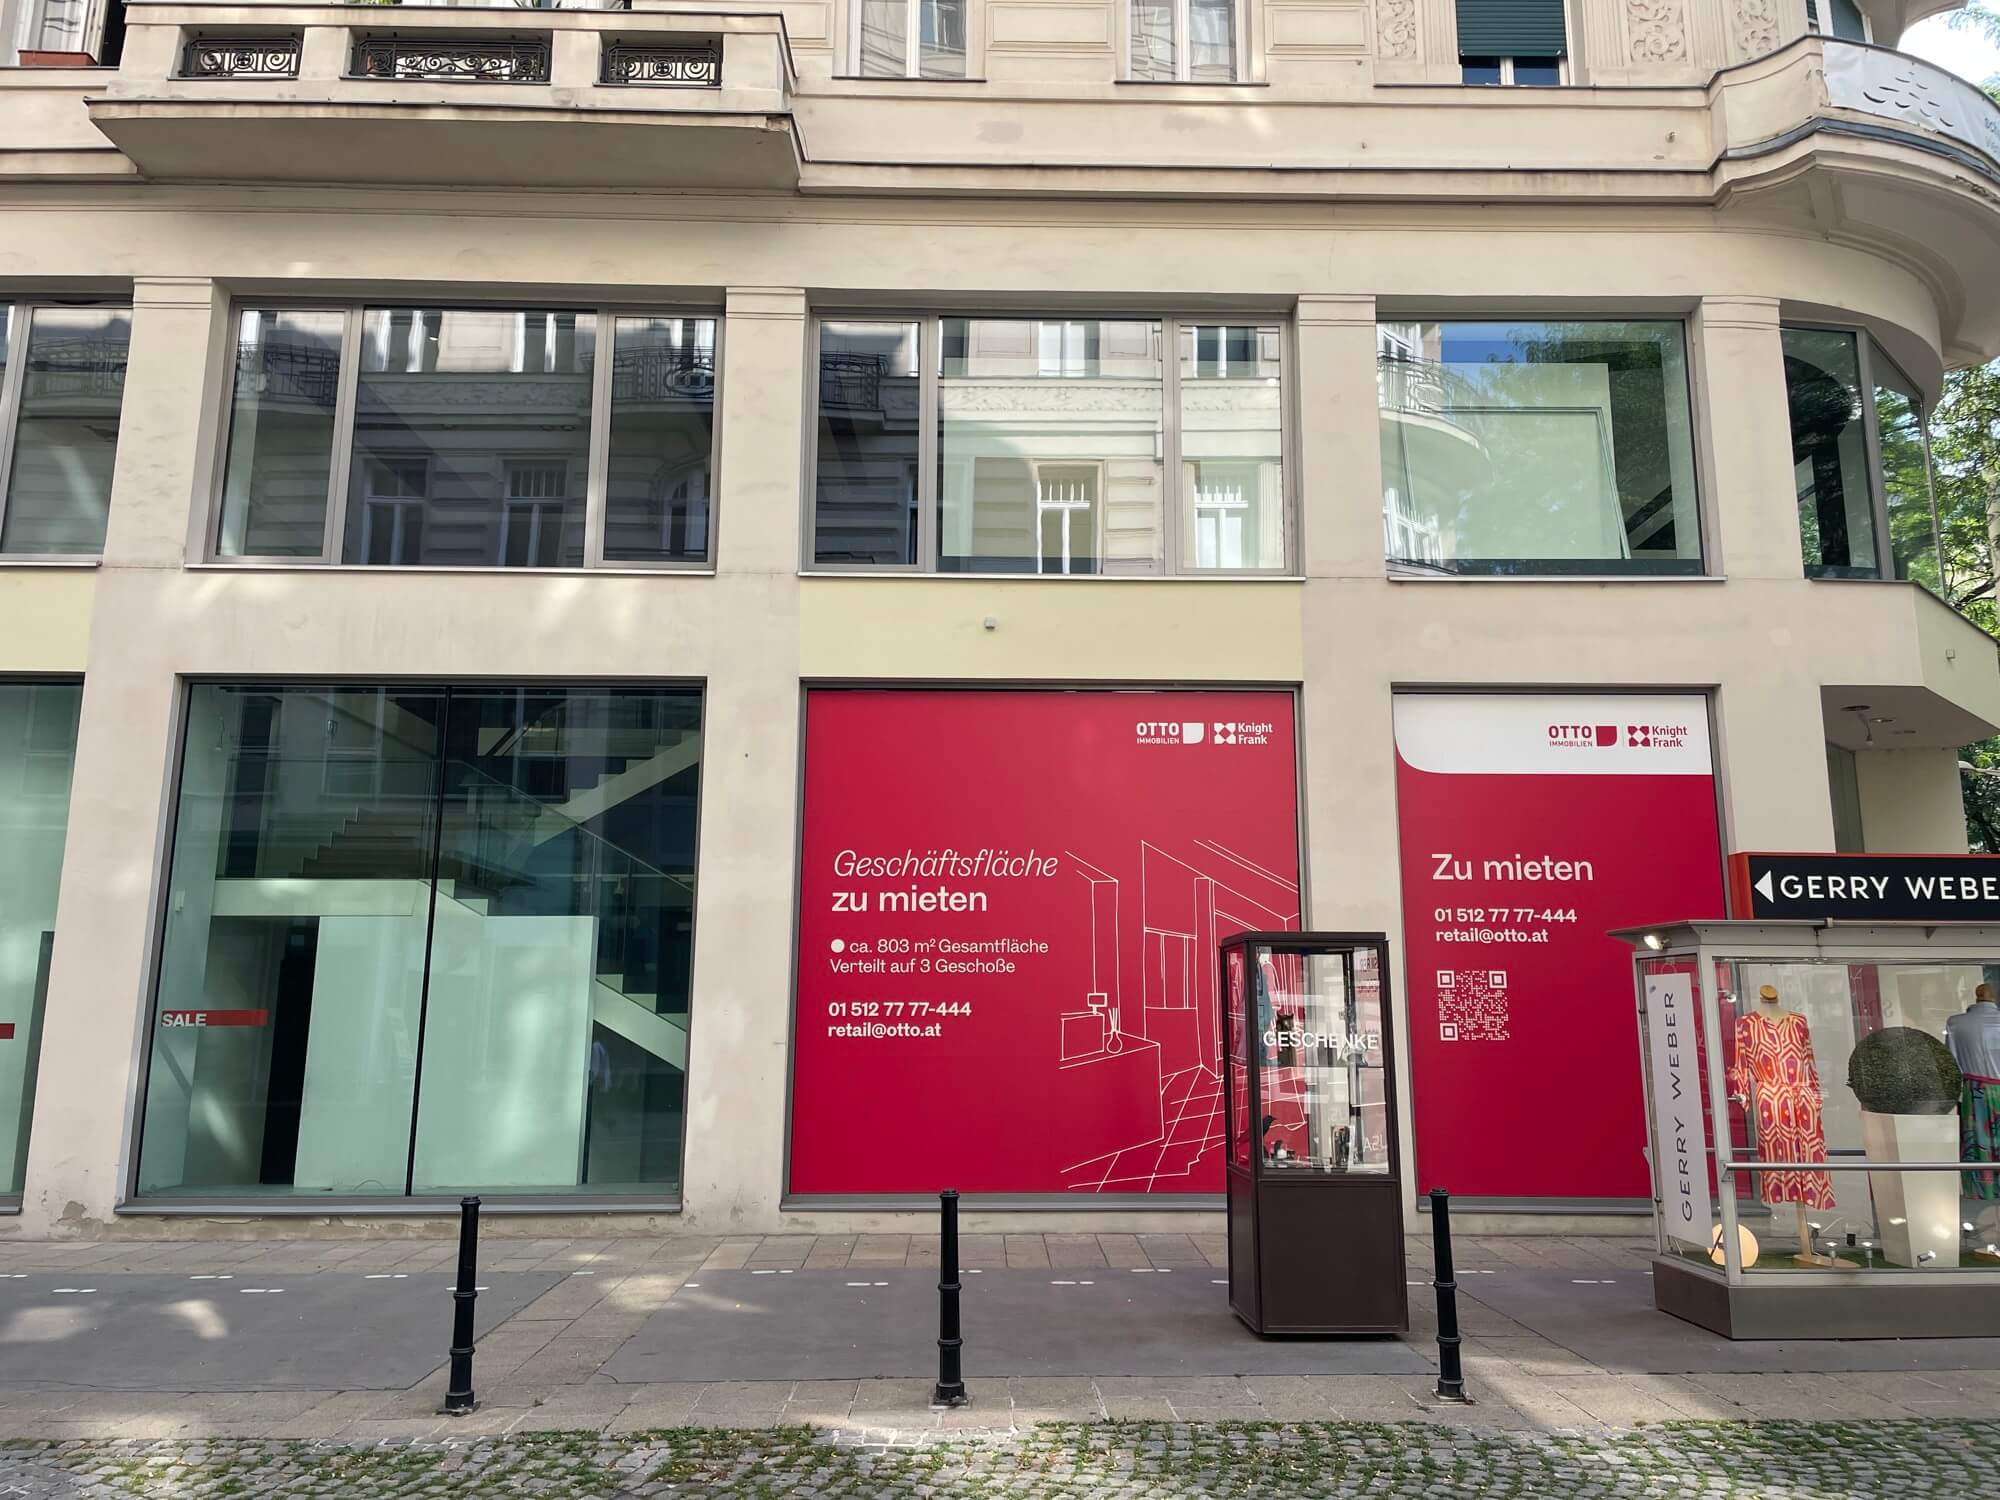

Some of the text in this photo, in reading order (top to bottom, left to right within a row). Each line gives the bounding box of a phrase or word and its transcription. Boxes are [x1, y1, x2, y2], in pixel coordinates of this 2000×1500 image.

[1136, 722, 1179, 736] OTTO
[1238, 722, 1273, 735] Knight
[1548, 725, 1592, 739] OTTO
[1652, 725, 1688, 738] Knight
[1136, 737, 1180, 745] IMMOBILIEN
[1238, 735, 1268, 745] Frank
[1653, 738, 1683, 747] Frank
[834, 848, 1059, 877] Geschäftsfläche
[1431, 853, 1594, 881] Zu mieten
[1780, 875, 2000, 900] GERRY WEBE
[831, 884, 988, 912] zu mieten
[1434, 908, 1578, 922] 01 512 77 77-444
[1435, 927, 1549, 944] retail@otto.at
[849, 938, 1049, 953] ca. 803 m² Gesamtfläche
[829, 958, 1016, 973] Verteilt auf 3 Geschoße
[828, 1002, 972, 1017] 01 512 77 77-444
[161, 1013, 207, 1028] SALE
[827, 1021, 942, 1039] retail@otto.at
[1263, 1031, 1380, 1049] GESCHENKE
[1664, 992, 1693, 1222] GERRY WEBER
